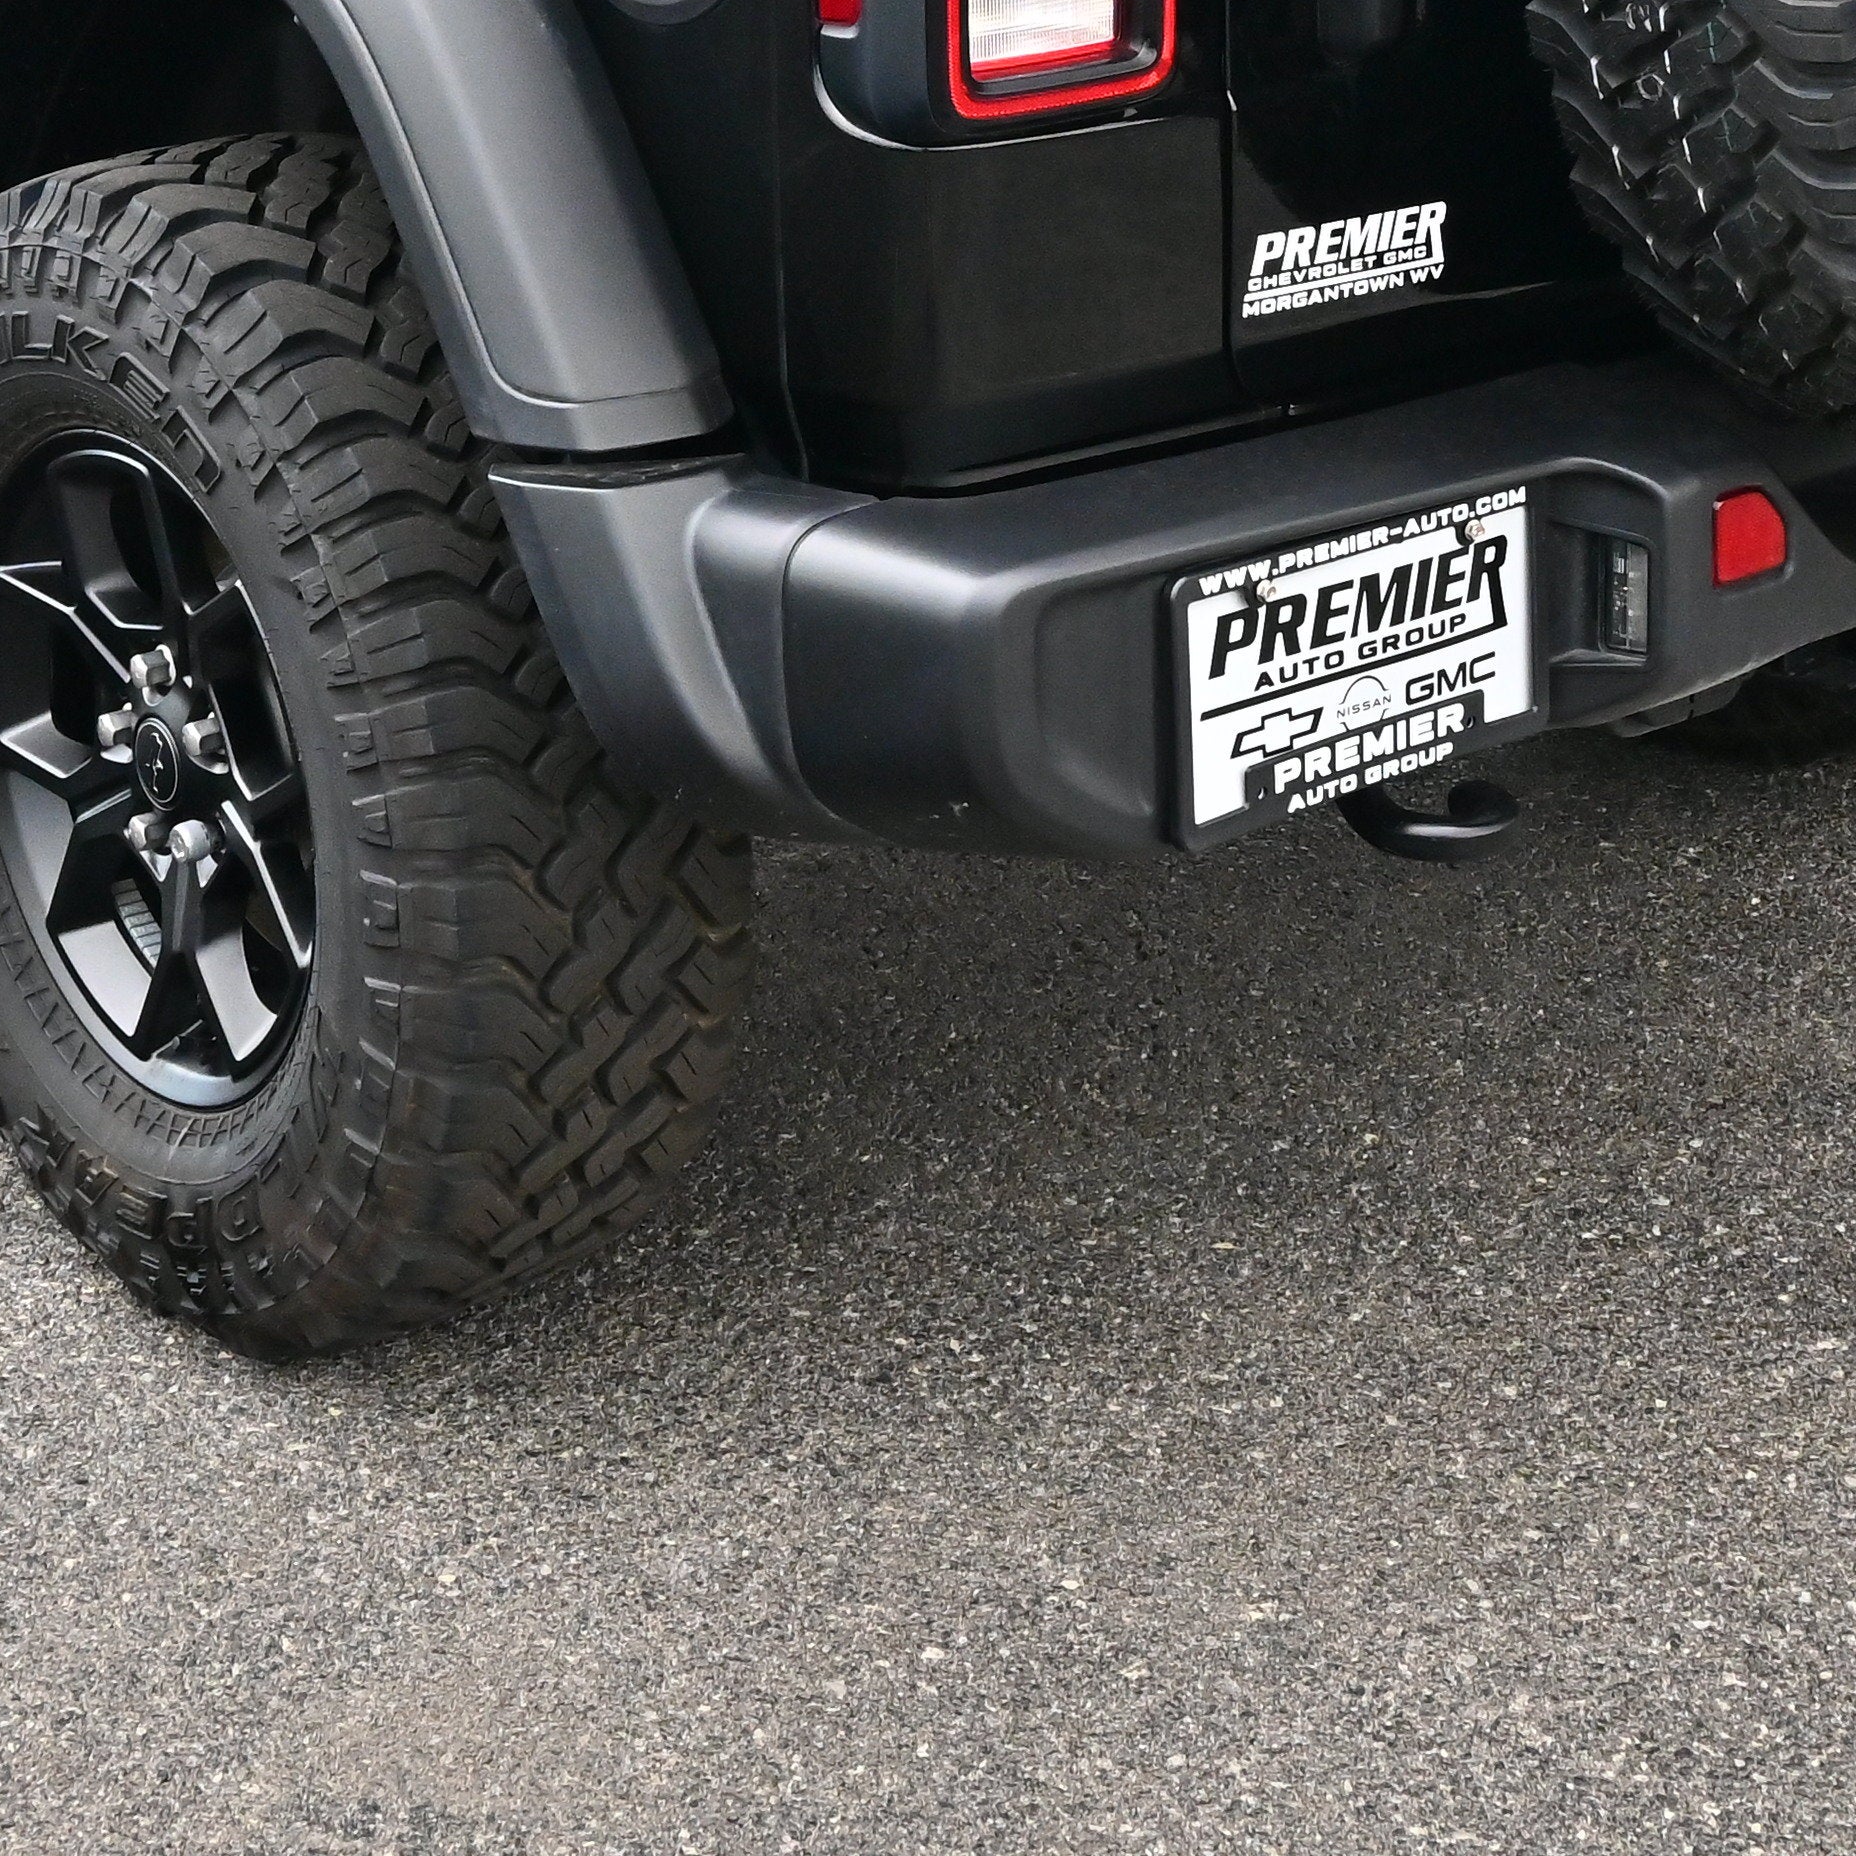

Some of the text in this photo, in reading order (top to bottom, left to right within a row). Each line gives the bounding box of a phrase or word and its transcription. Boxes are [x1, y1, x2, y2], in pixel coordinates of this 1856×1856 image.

[1247, 244, 1428, 292] CHEVROLET GMC
[1250, 200, 1447, 277] PREMIER
[1242, 263, 1445, 318] MORGANTOWN WV
[1198, 486, 1527, 596] WWW.PREMIER-AUTO.COM
[1208, 534, 1508, 680] PREMIER
[1254, 613, 1467, 692] AUTO GROUP
[1405, 651, 1496, 706] GMC
[1336, 693, 1393, 719] NISSAN
[1273, 702, 1467, 795] PREMIER
[1287, 742, 1454, 813] AUTO GROUP
